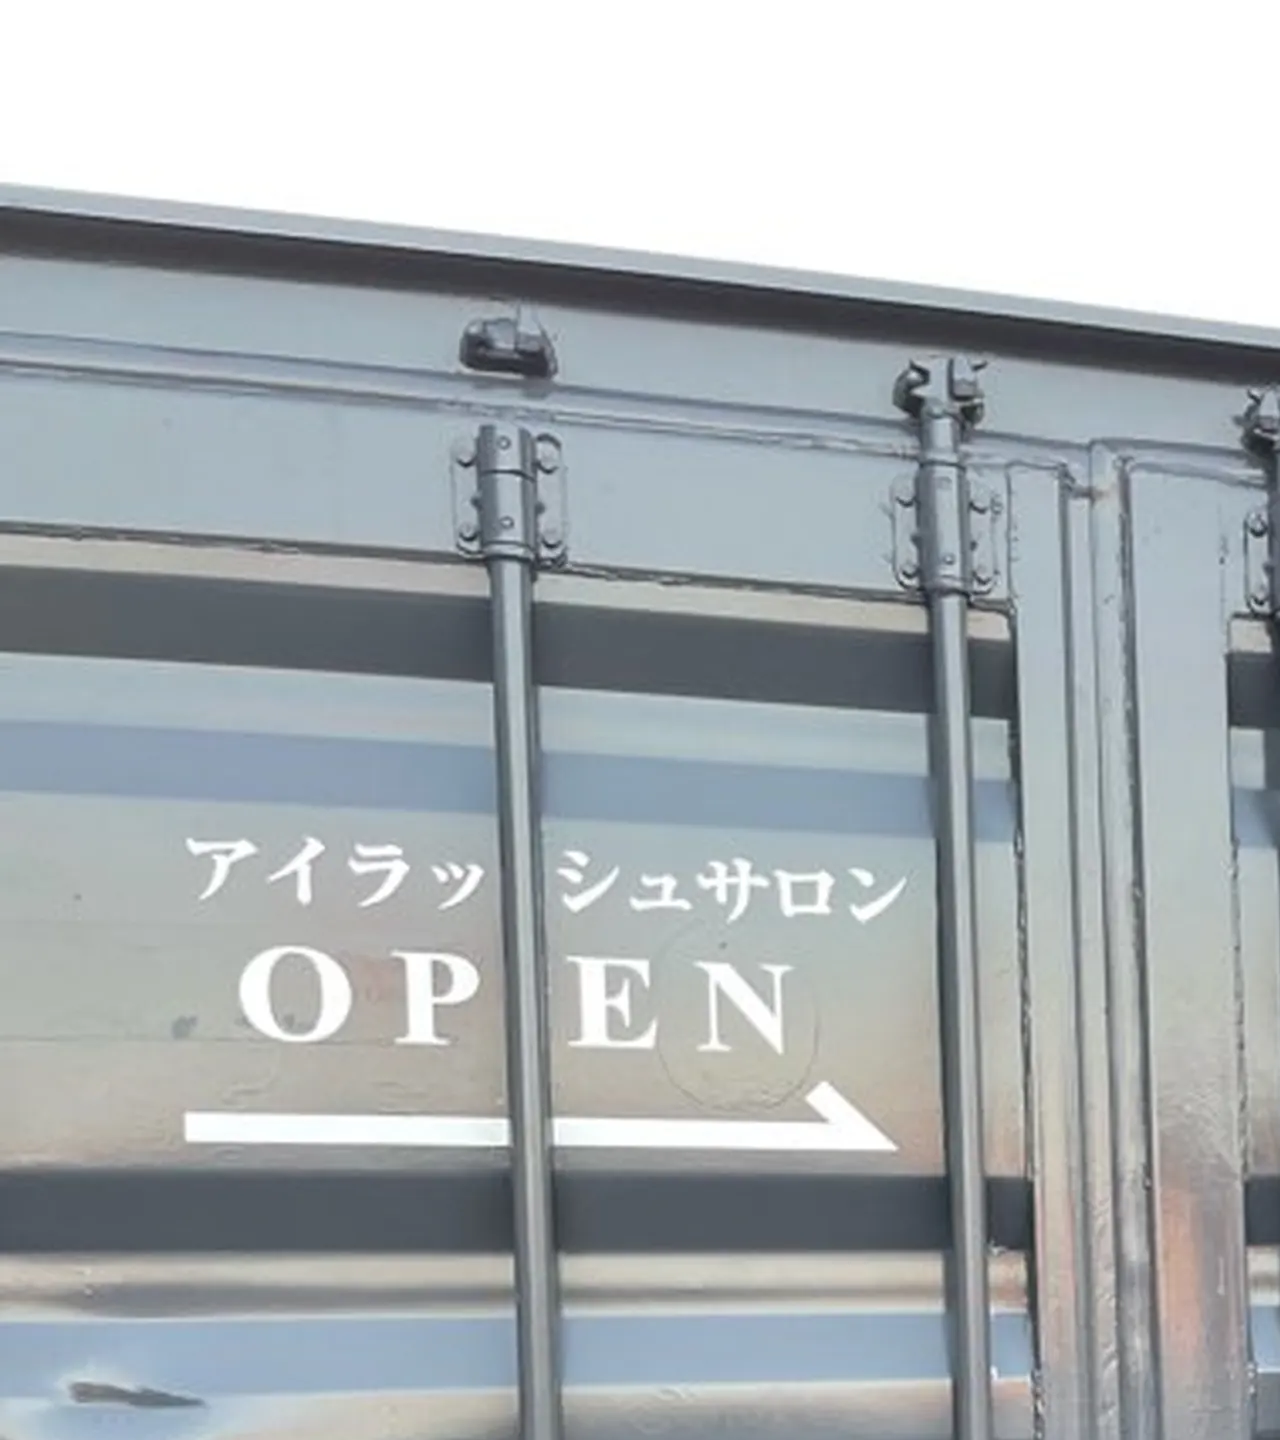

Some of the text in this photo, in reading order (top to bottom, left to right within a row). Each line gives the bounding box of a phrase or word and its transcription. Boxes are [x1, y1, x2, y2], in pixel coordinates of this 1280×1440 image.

[184, 836, 907, 924] アイラッシュサロン
[238, 945, 796, 1055] OPEN
